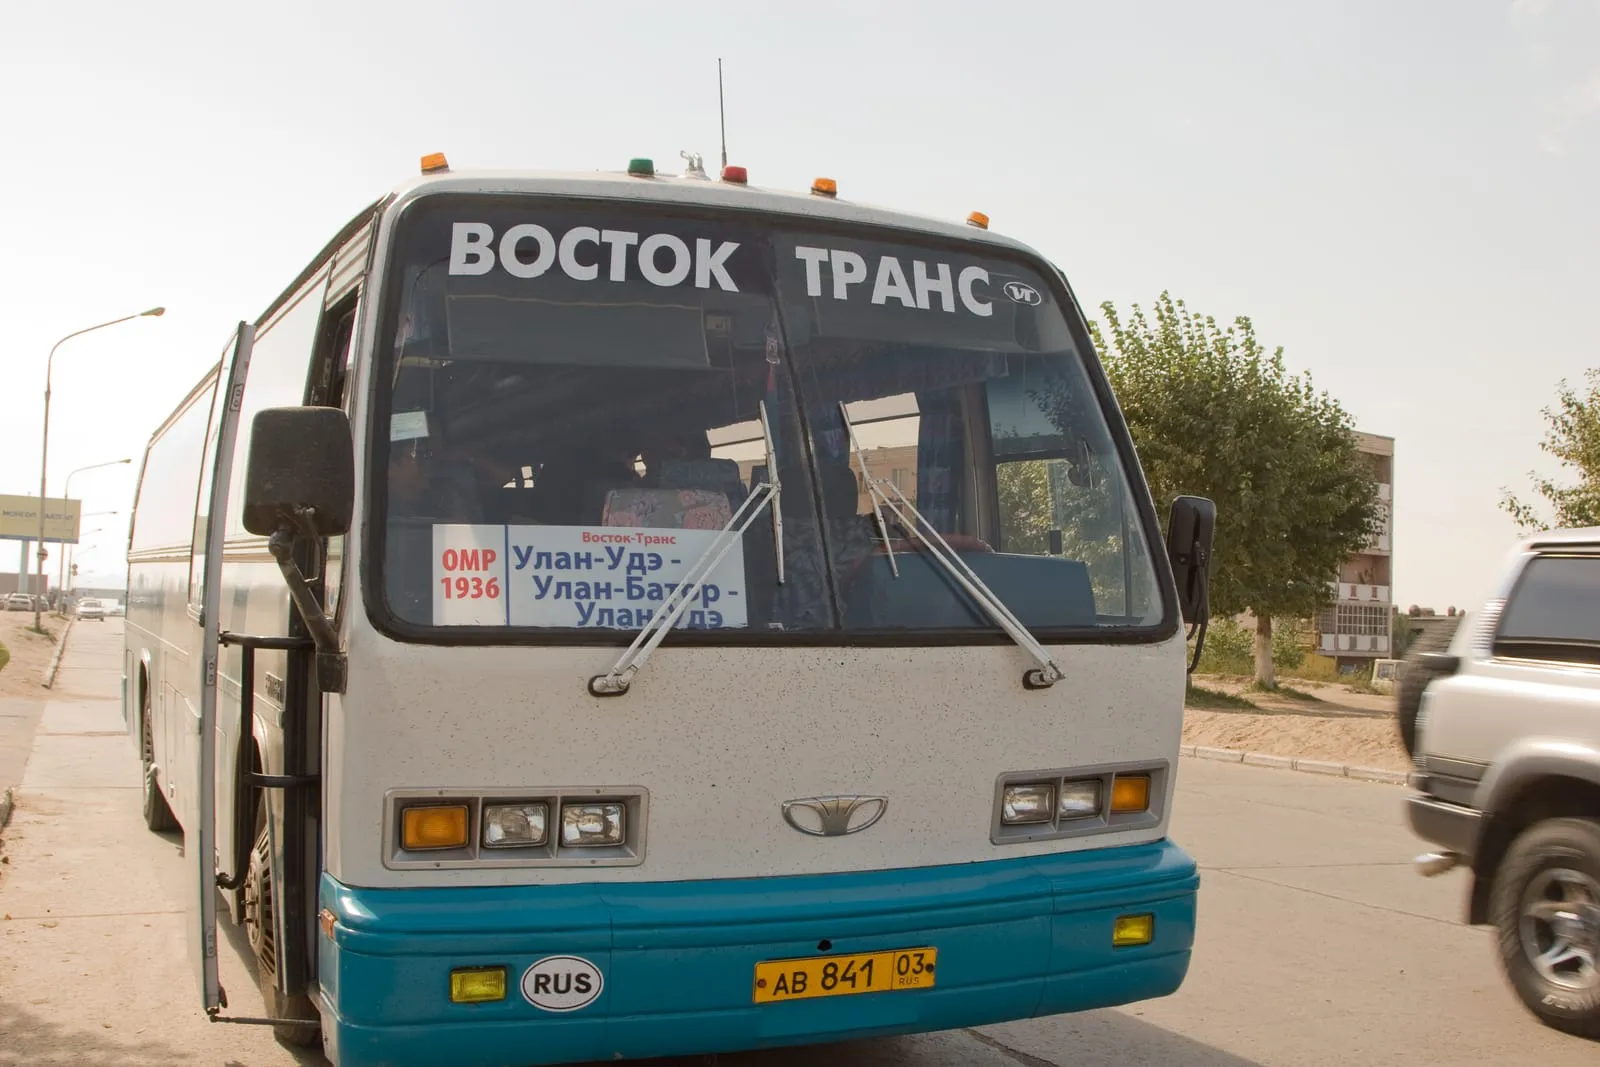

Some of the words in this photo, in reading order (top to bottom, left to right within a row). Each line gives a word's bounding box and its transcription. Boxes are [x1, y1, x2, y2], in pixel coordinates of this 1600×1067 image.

[448, 221, 741, 293] ВОСТОК
[795, 246, 994, 317] ТРАНС
[582, 532, 676, 545] Восток-Транс
[442, 549, 496, 571] ОМР
[512, 546, 663, 575] Улан-Удэ
[440, 577, 500, 600] 1936
[821, 958, 874, 991] 841
[896, 953, 925, 976] 03
[898, 976, 919, 985] RUS
[533, 973, 591, 995] RUS
